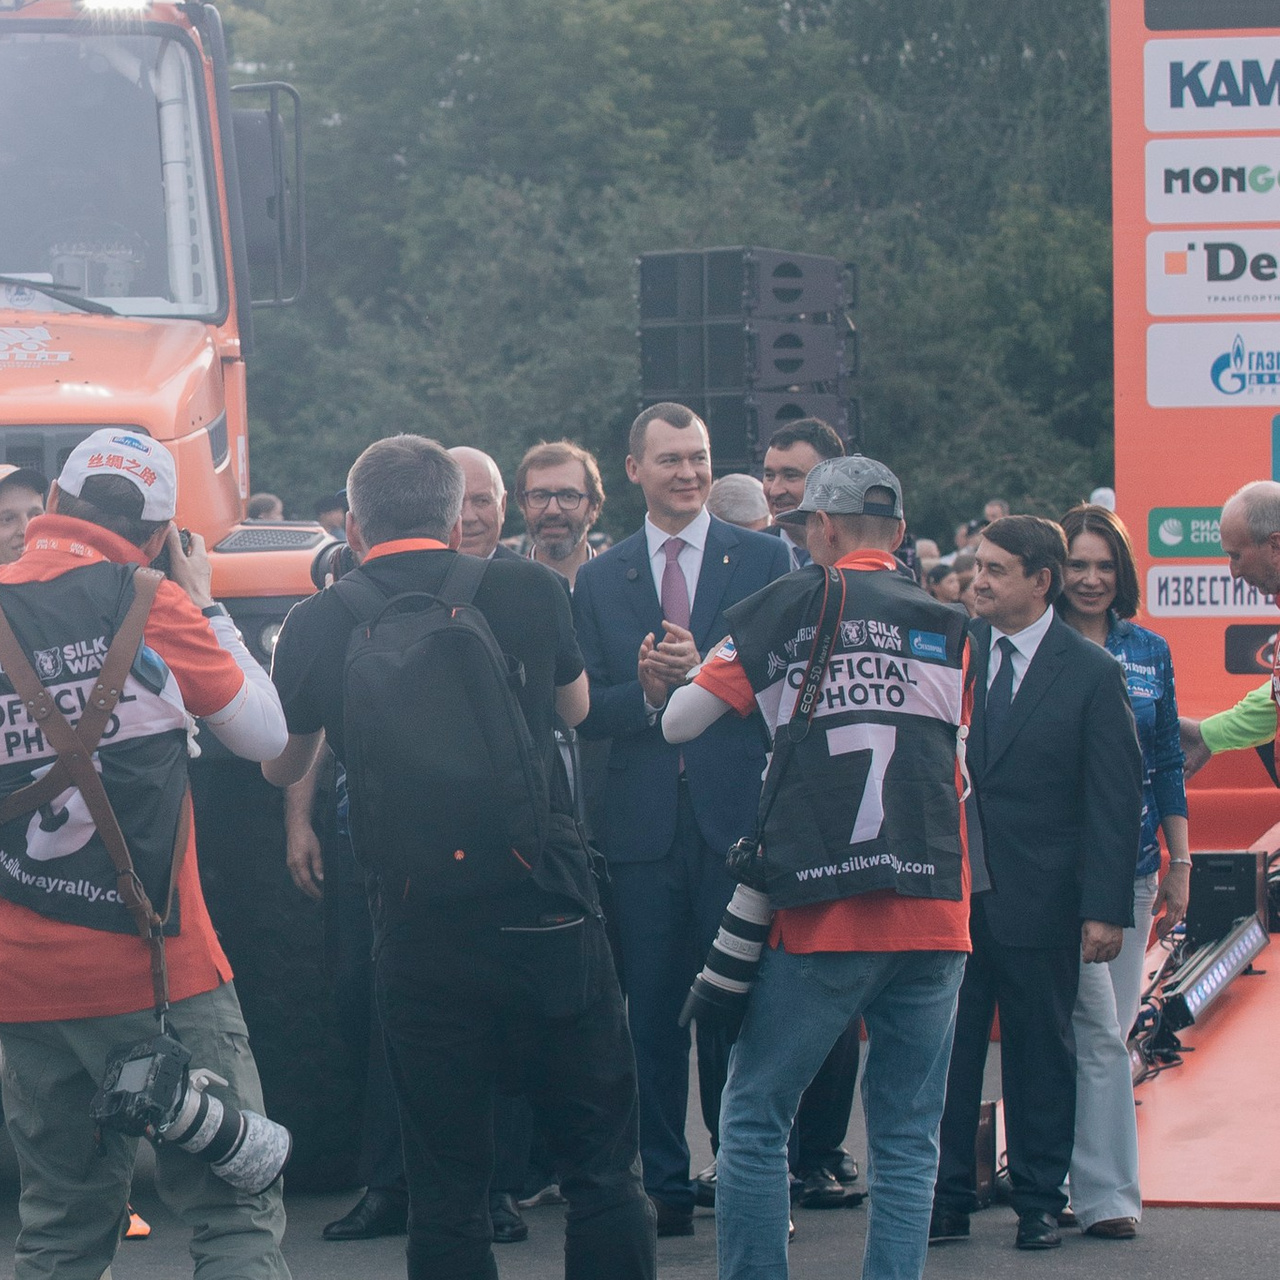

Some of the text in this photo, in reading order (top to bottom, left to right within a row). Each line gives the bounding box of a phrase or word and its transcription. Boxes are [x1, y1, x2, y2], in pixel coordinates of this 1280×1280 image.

[1164, 164, 1280, 194] MONG
[867, 620, 901, 639] SILK
[869, 634, 903, 652] WAY
[63, 636, 108, 660] SILK
[787, 657, 918, 690] OFICIAL
[800, 683, 817, 714] EOS
[810, 665, 823, 683] 5D
[826, 723, 897, 846] 7
